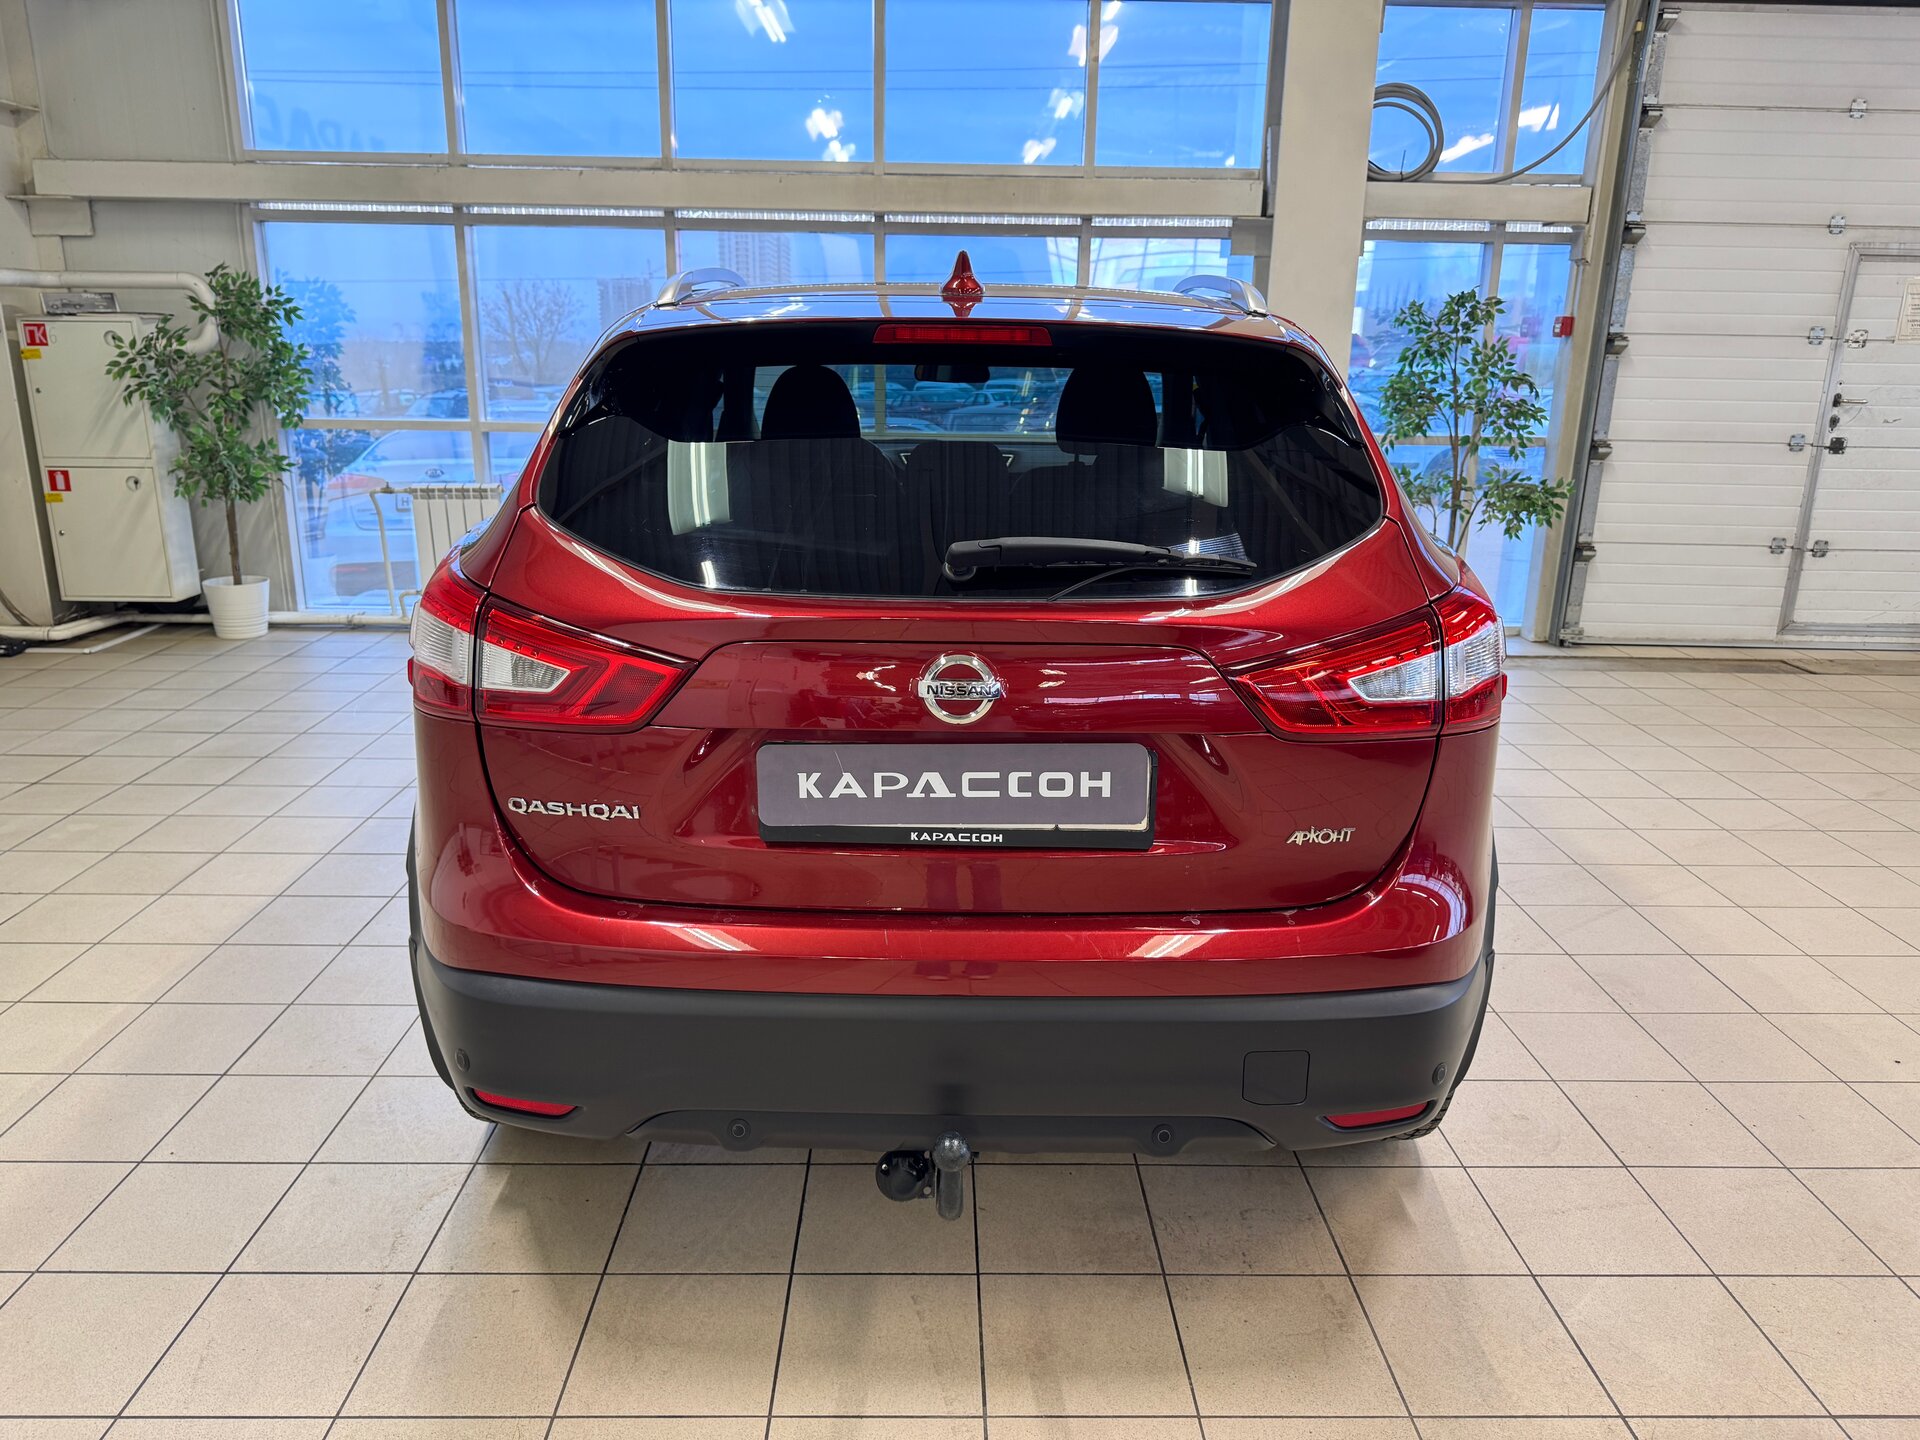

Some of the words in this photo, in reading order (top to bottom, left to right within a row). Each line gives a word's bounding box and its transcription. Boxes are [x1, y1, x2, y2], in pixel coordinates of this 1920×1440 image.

[24, 326, 47, 344] ПК
[926, 684, 992, 696] NISSAN
[507, 797, 641, 821] QASHQAI
[1286, 826, 1356, 846] АРКОНТ
